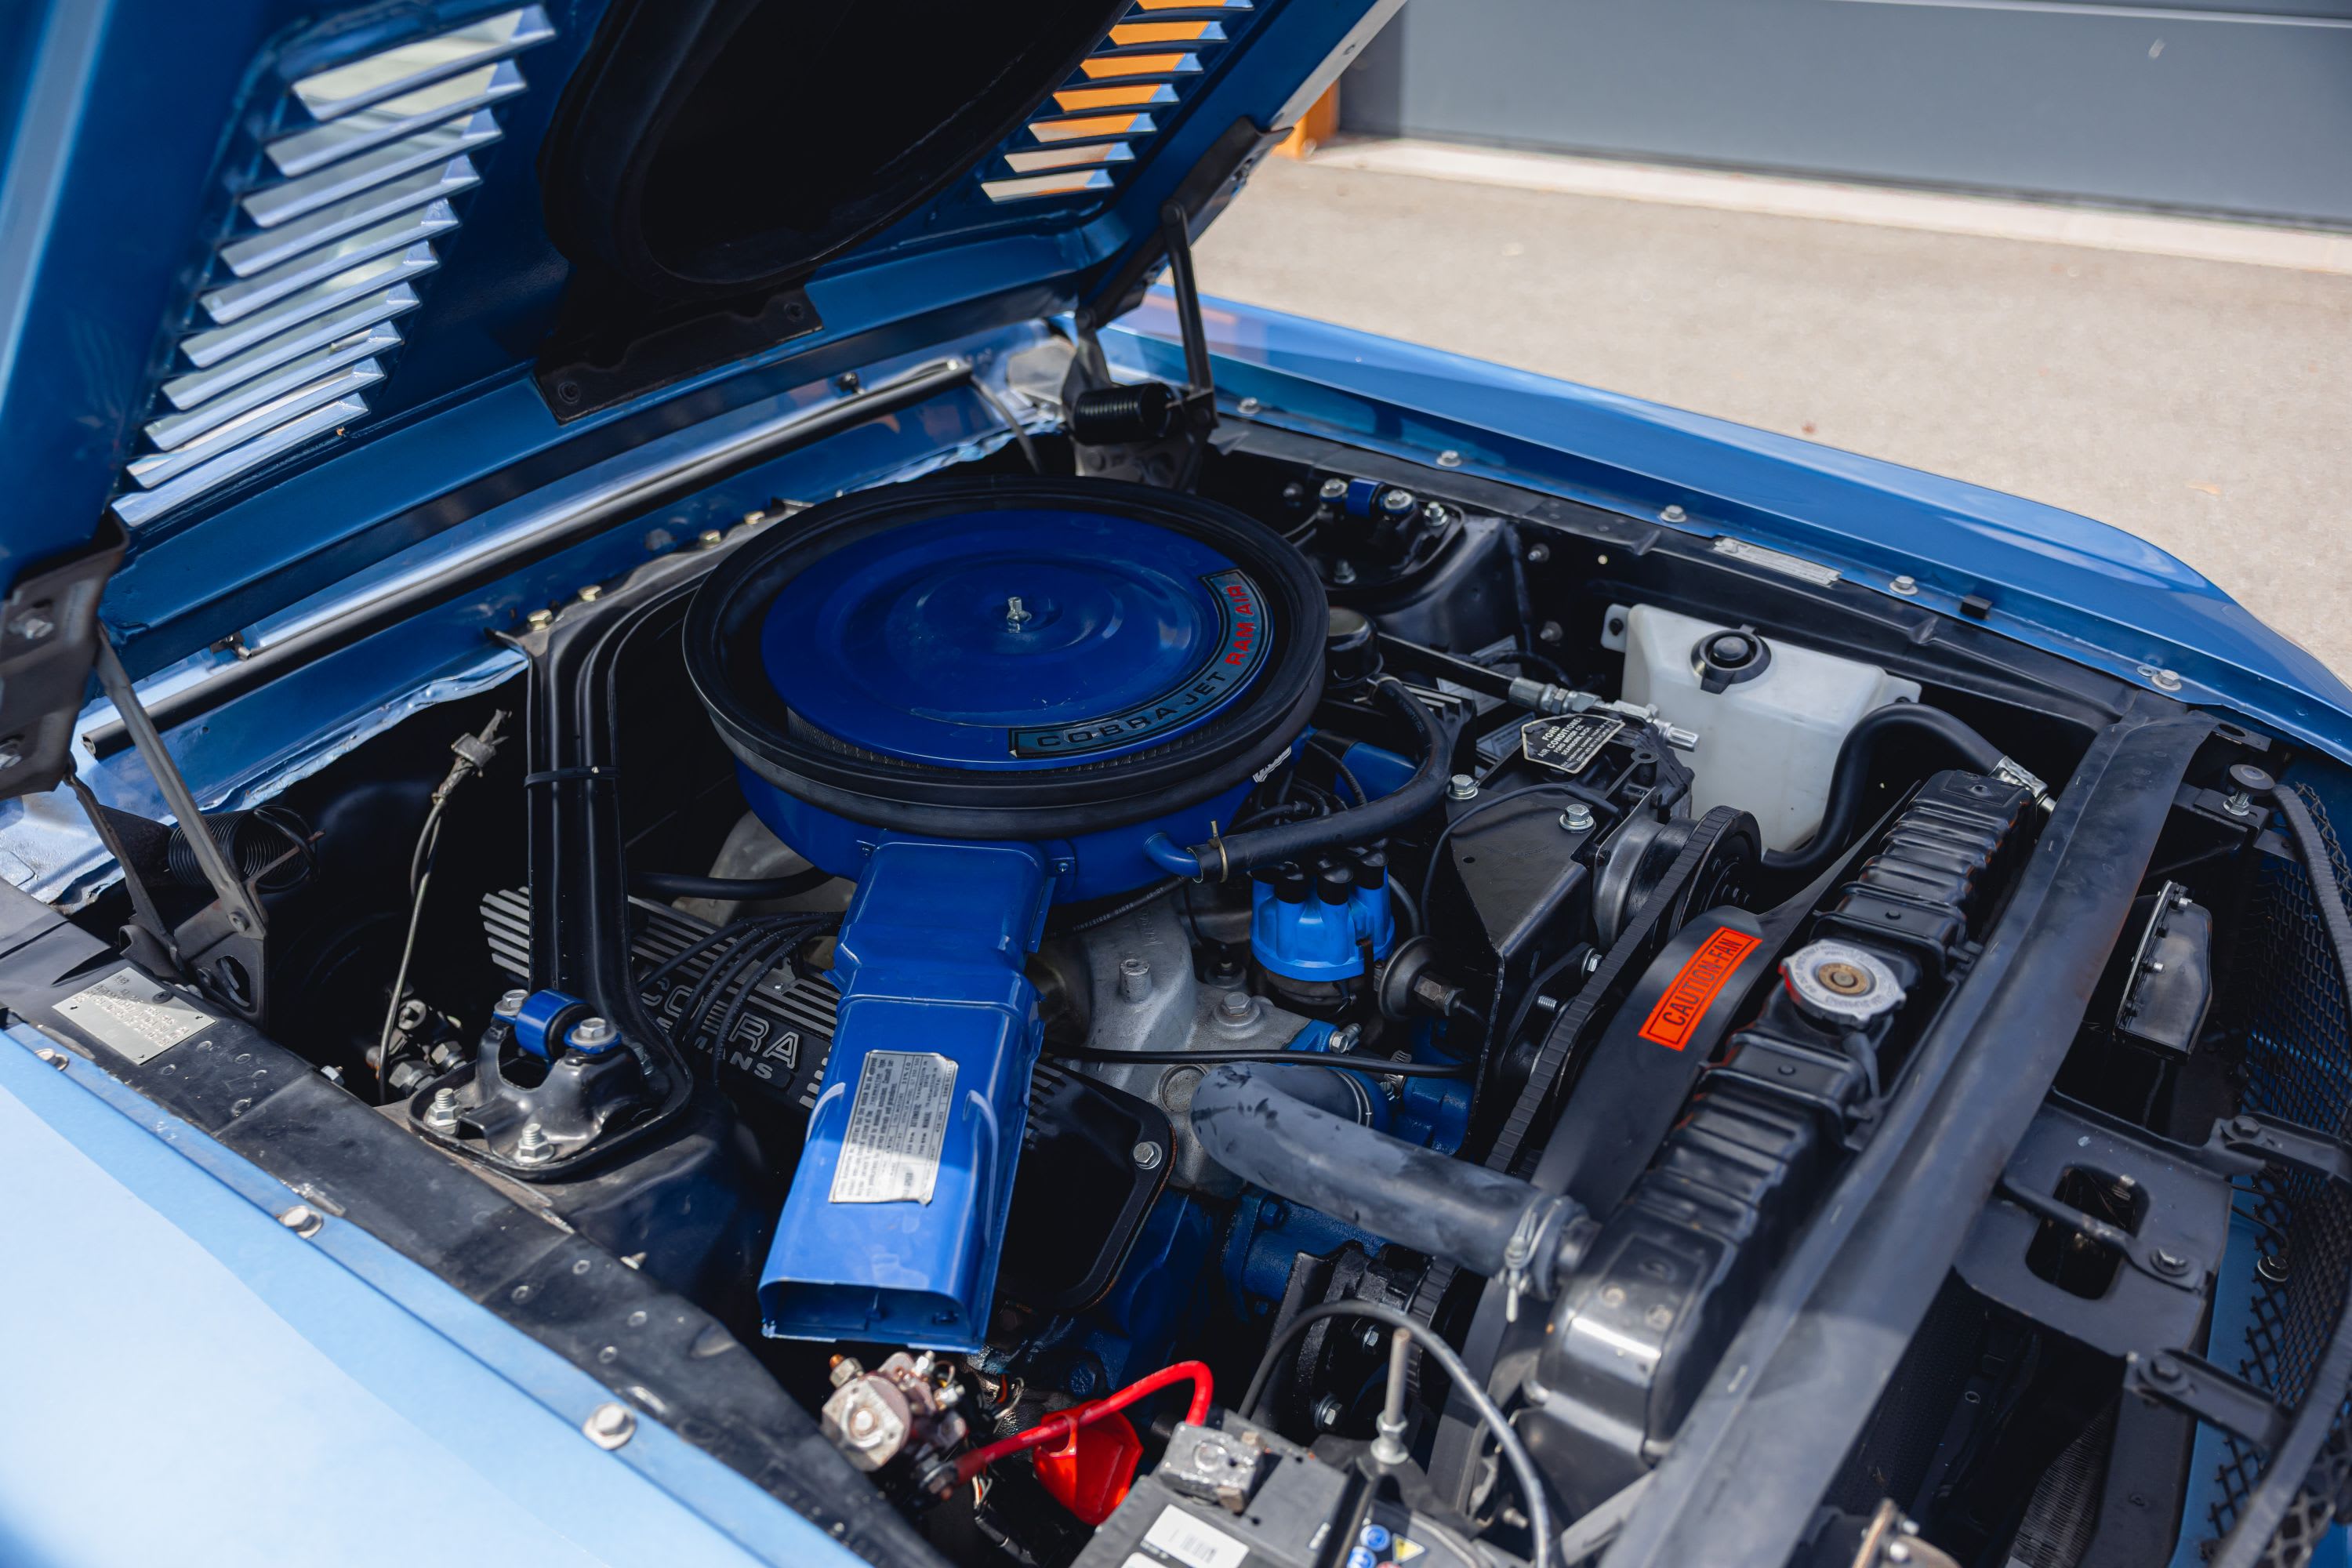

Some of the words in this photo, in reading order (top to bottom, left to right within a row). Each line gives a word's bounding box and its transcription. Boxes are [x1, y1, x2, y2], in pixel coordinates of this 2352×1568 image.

[1226, 584, 1254, 616] AIR
[1225, 621, 1255, 666] RAM
[1184, 671, 1228, 706] JET
[1036, 706, 1178, 747] COBRA
[1541, 725, 1560, 741] FORD
[1553, 742, 1566, 753] FORD
[1563, 730, 1578, 743] MOTOR
[1537, 748, 1551, 758] AIR
[1115, 902, 1134, 915] RADIO
[1661, 937, 1744, 1027] CAUTION-FAN
